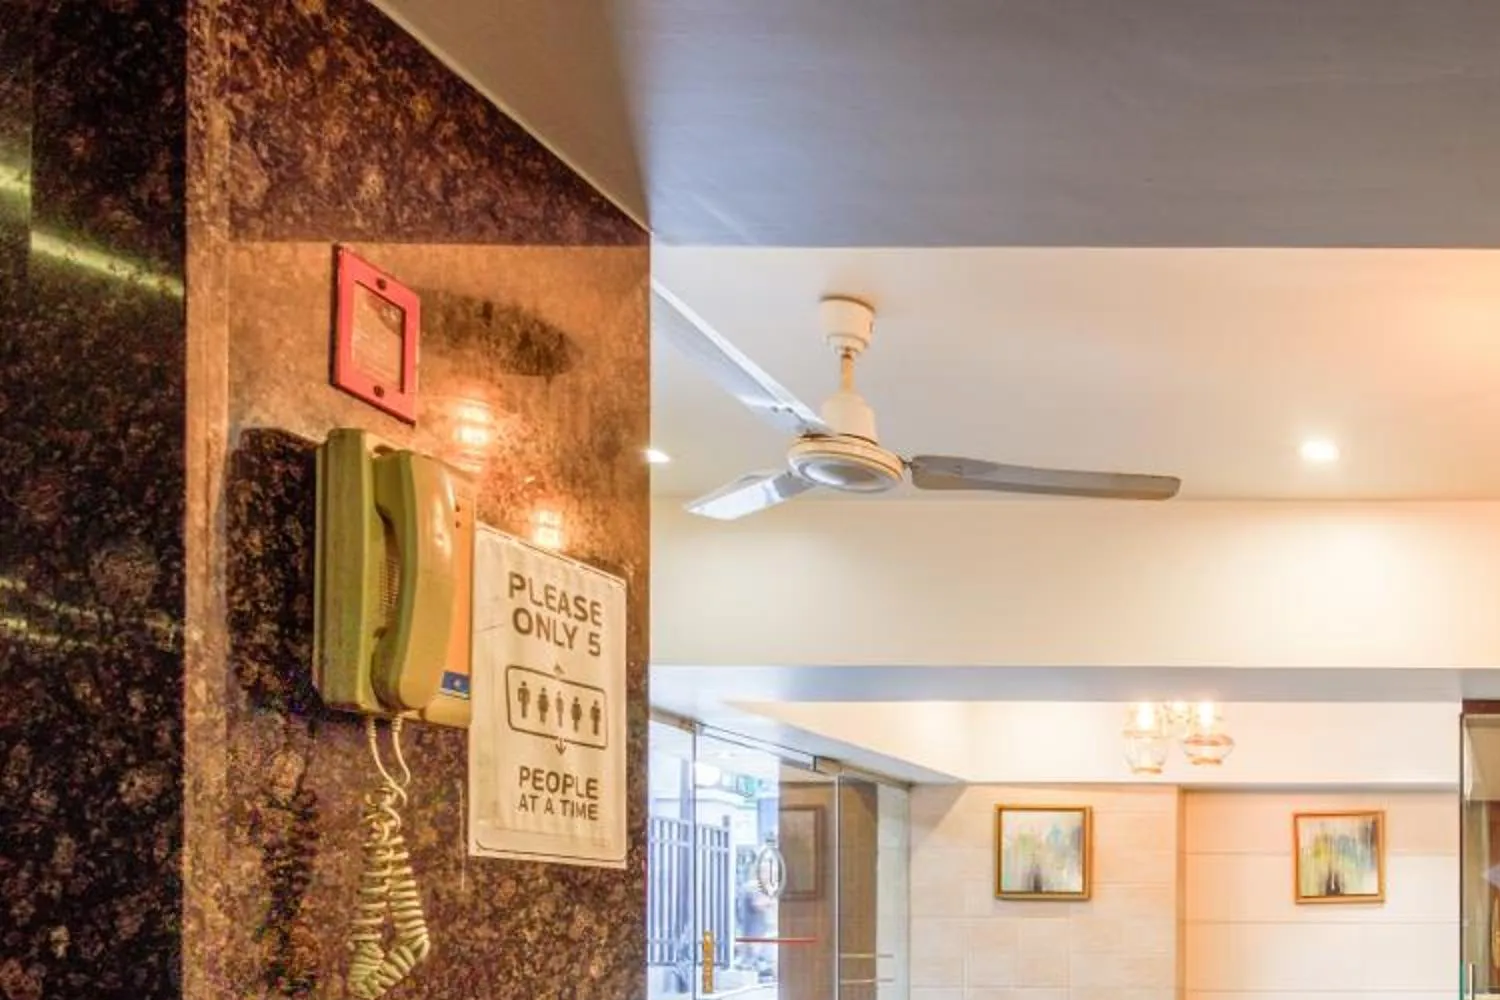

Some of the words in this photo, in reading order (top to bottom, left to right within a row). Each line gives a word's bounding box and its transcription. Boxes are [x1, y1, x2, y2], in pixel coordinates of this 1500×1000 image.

[509, 571, 602, 627] PLEASE
[512, 607, 578, 650] ONLY
[588, 631, 601, 656] 5
[519, 766, 598, 800] PEOPLE
[519, 793, 540, 813] AT
[544, 797, 554, 815] A
[560, 799, 598, 820] TIME
